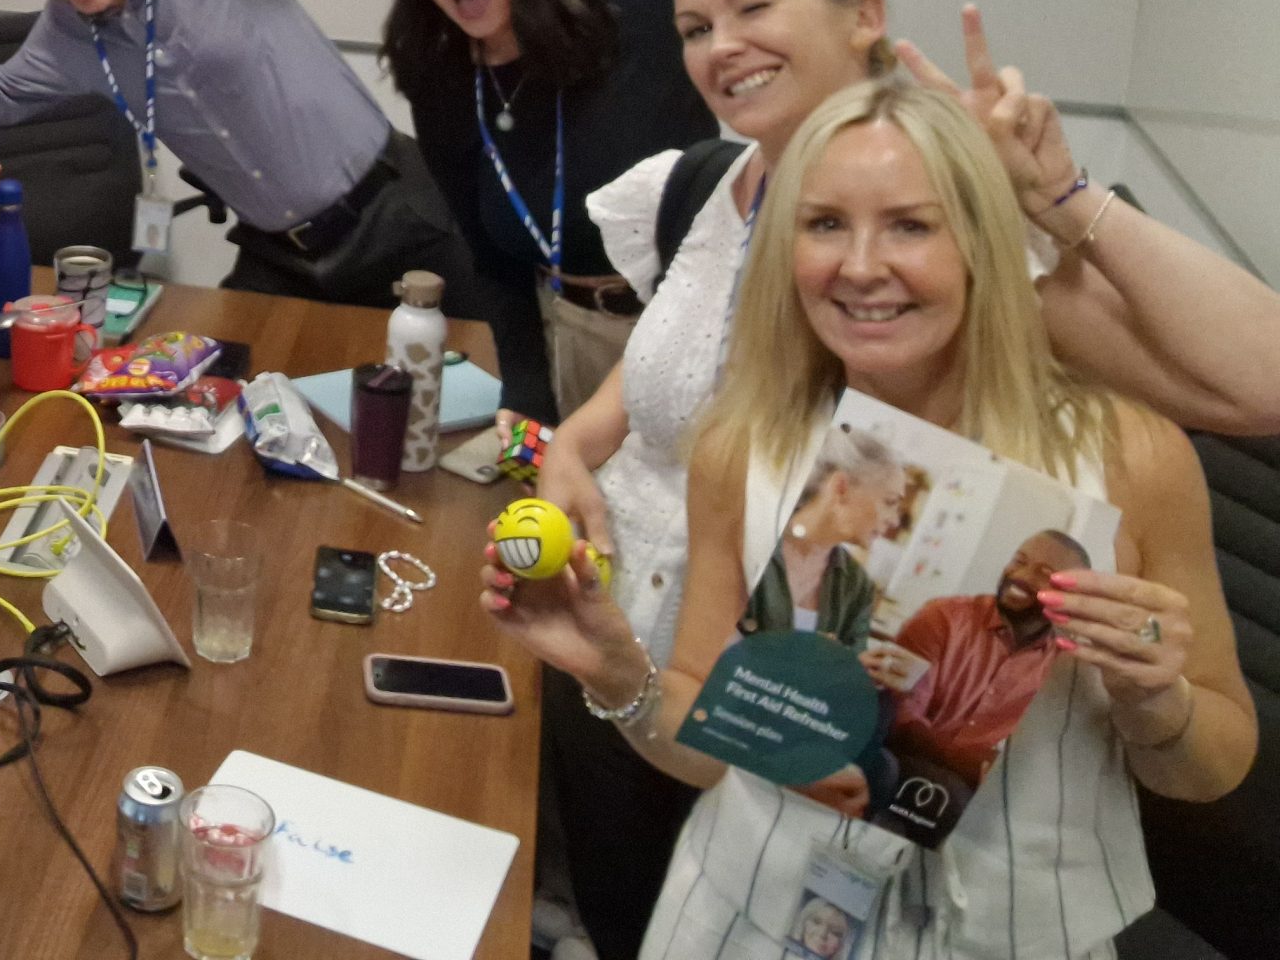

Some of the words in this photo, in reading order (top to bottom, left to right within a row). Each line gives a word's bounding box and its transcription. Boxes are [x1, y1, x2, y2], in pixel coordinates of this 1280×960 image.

[725, 680, 759, 704] First
[756, 695, 784, 714] Aid
[782, 704, 850, 742] Refresher
[733, 665, 785, 696] Mental
[783, 685, 829, 716] Health
